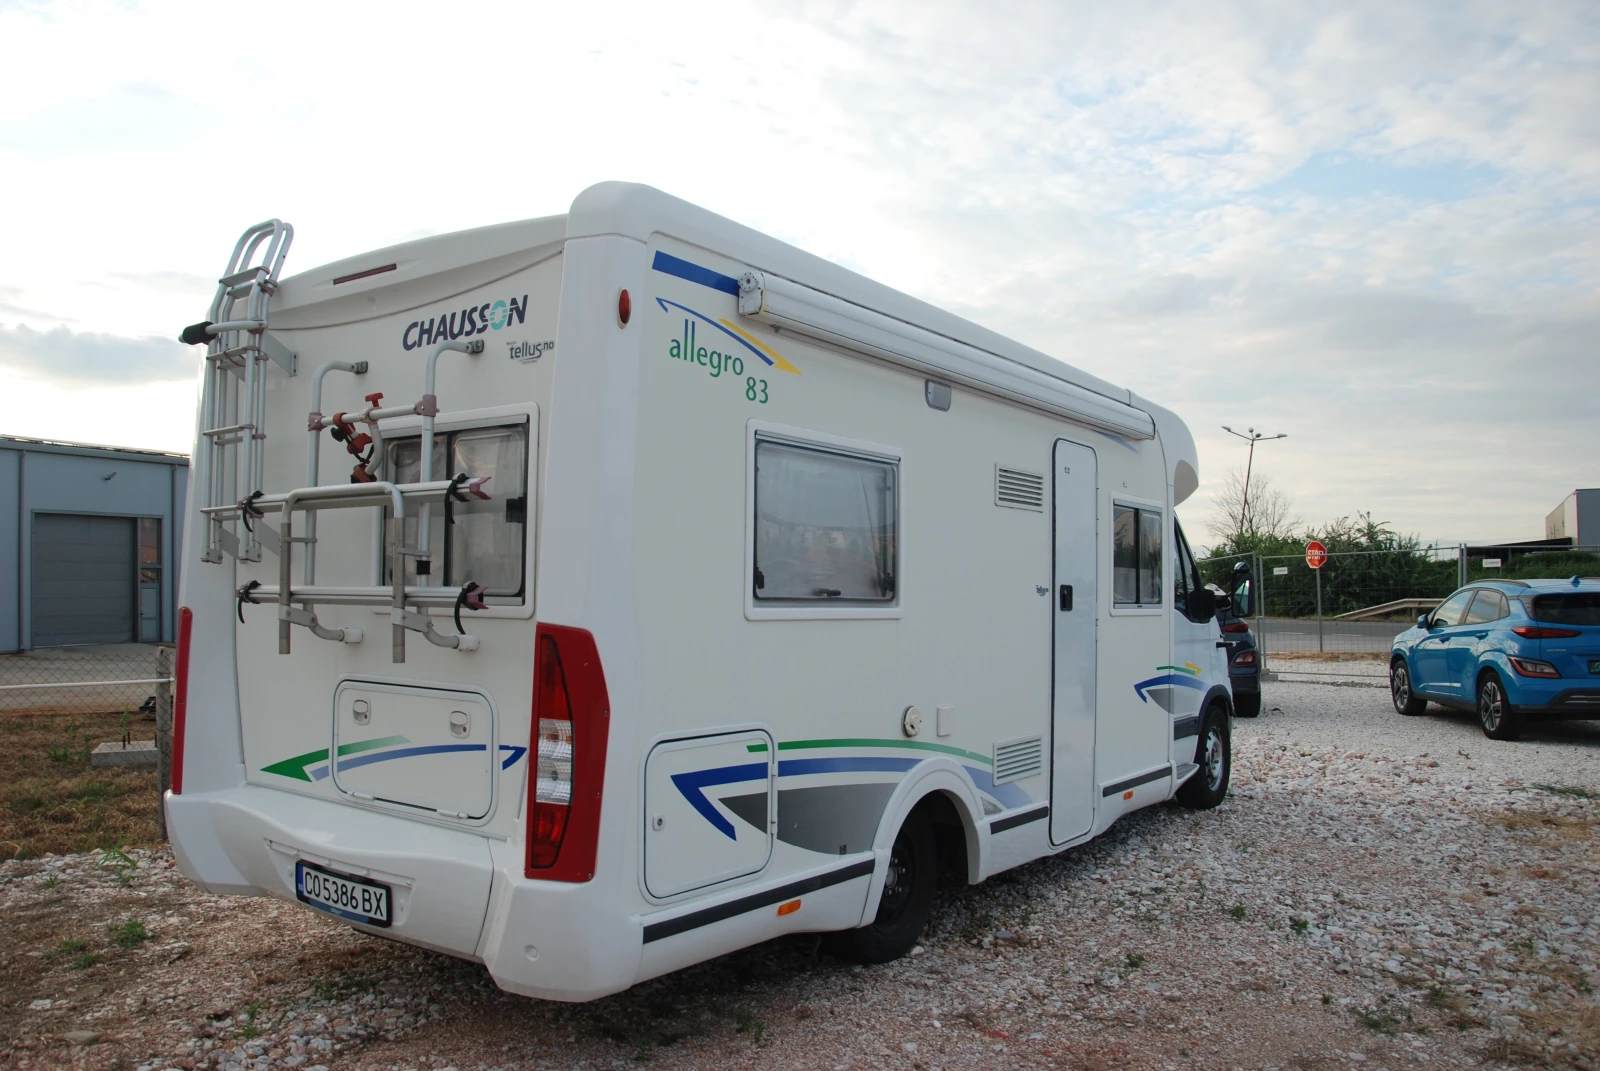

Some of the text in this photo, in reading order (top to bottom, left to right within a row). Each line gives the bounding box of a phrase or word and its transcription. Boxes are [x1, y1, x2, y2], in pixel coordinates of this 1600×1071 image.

[402, 294, 529, 351] CHAUSSON
[510, 341, 555, 360] tellus.no
[669, 318, 744, 378] allegro
[745, 376, 769, 404] 83
[1307, 549, 1325, 560] STOP
